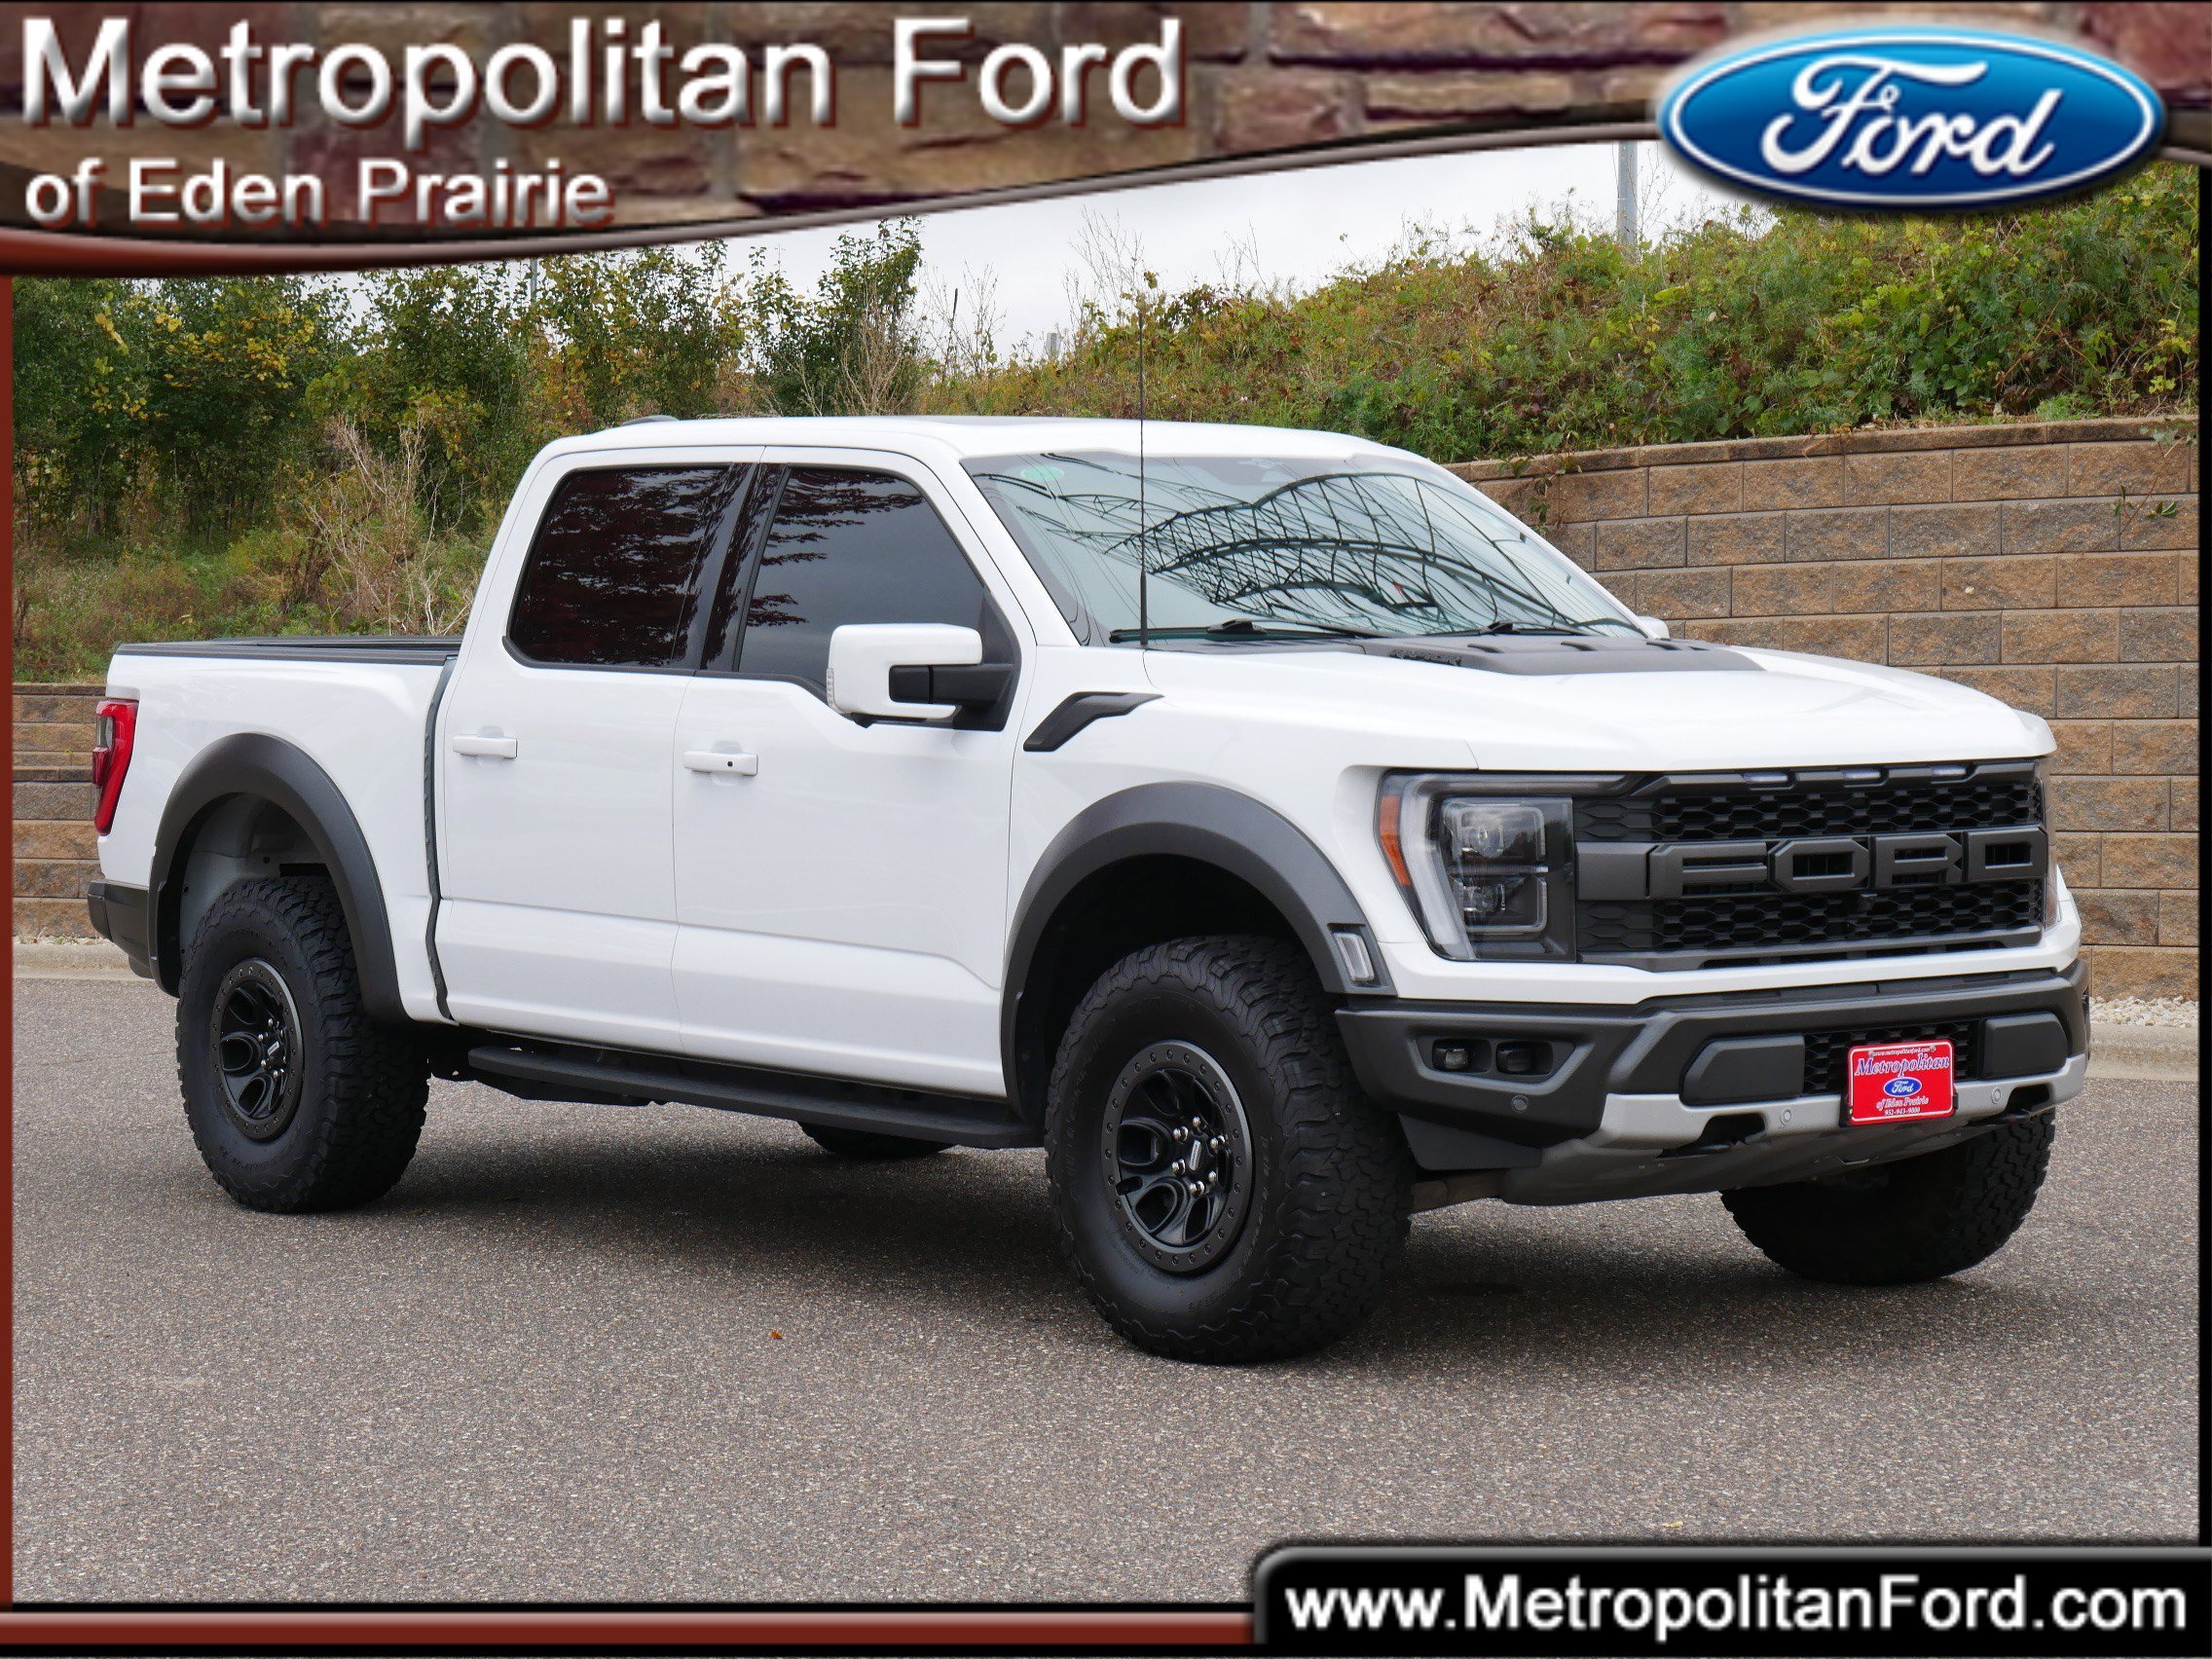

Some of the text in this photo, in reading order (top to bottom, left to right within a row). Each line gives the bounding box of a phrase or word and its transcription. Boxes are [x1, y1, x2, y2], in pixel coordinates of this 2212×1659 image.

[1650, 827, 2047, 900] FORD
[1854, 1052, 1950, 1078] Metropolitan
[1892, 1080, 1913, 1093] Ford
